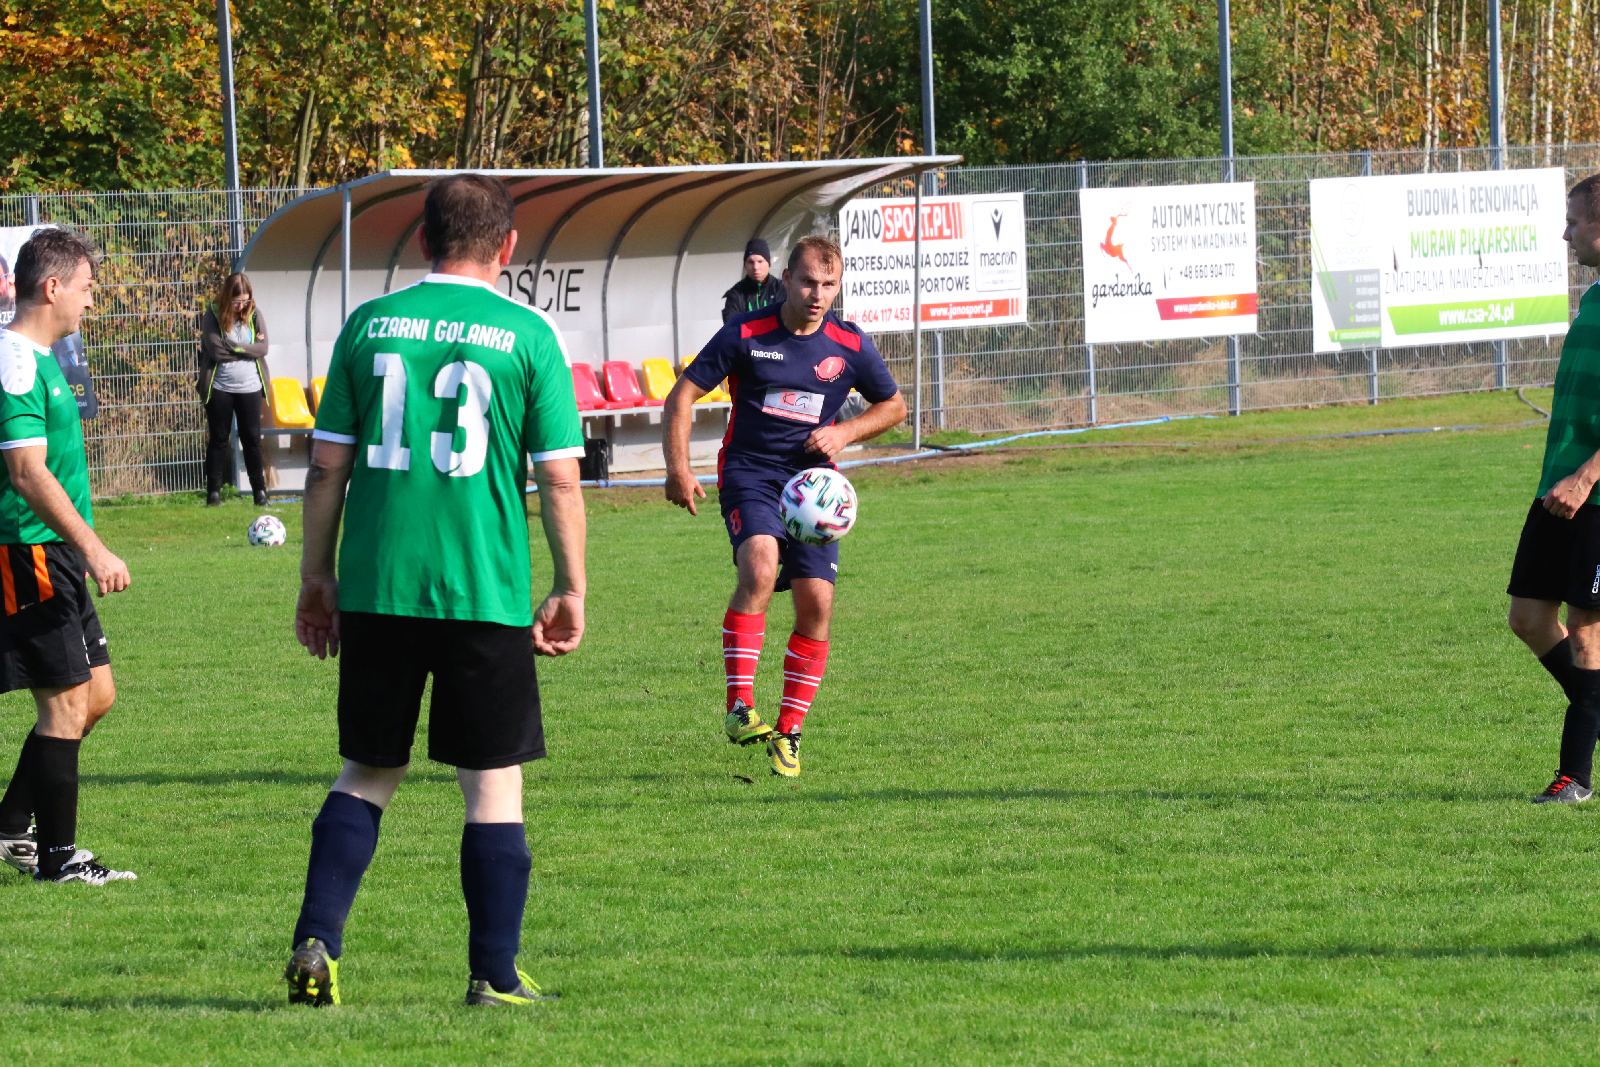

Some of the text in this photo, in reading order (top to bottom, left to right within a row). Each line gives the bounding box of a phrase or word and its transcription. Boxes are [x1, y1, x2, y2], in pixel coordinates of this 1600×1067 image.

[1407, 188, 1459, 217] BUDOWA
[1470, 183, 1538, 218] RENOWACJA
[1152, 202, 1246, 229] AUTOMATYCZNE
[1151, 232, 1248, 252] SYSTEMY NAWADNIANIA
[1411, 229, 1457, 258] MURAW
[934, 247, 969, 268] ODZIEŻ
[852, 280, 911, 297] AKCESORIA
[919, 275, 970, 294] PORTOWE
[1092, 272, 1153, 309] gardenika
[862, 308, 879, 323] 604
[894, 307, 910, 321] 453
[368, 317, 516, 354] CZARNI GOLANKA
[751, 349, 784, 361] macron
[366, 351, 493, 478] 13
